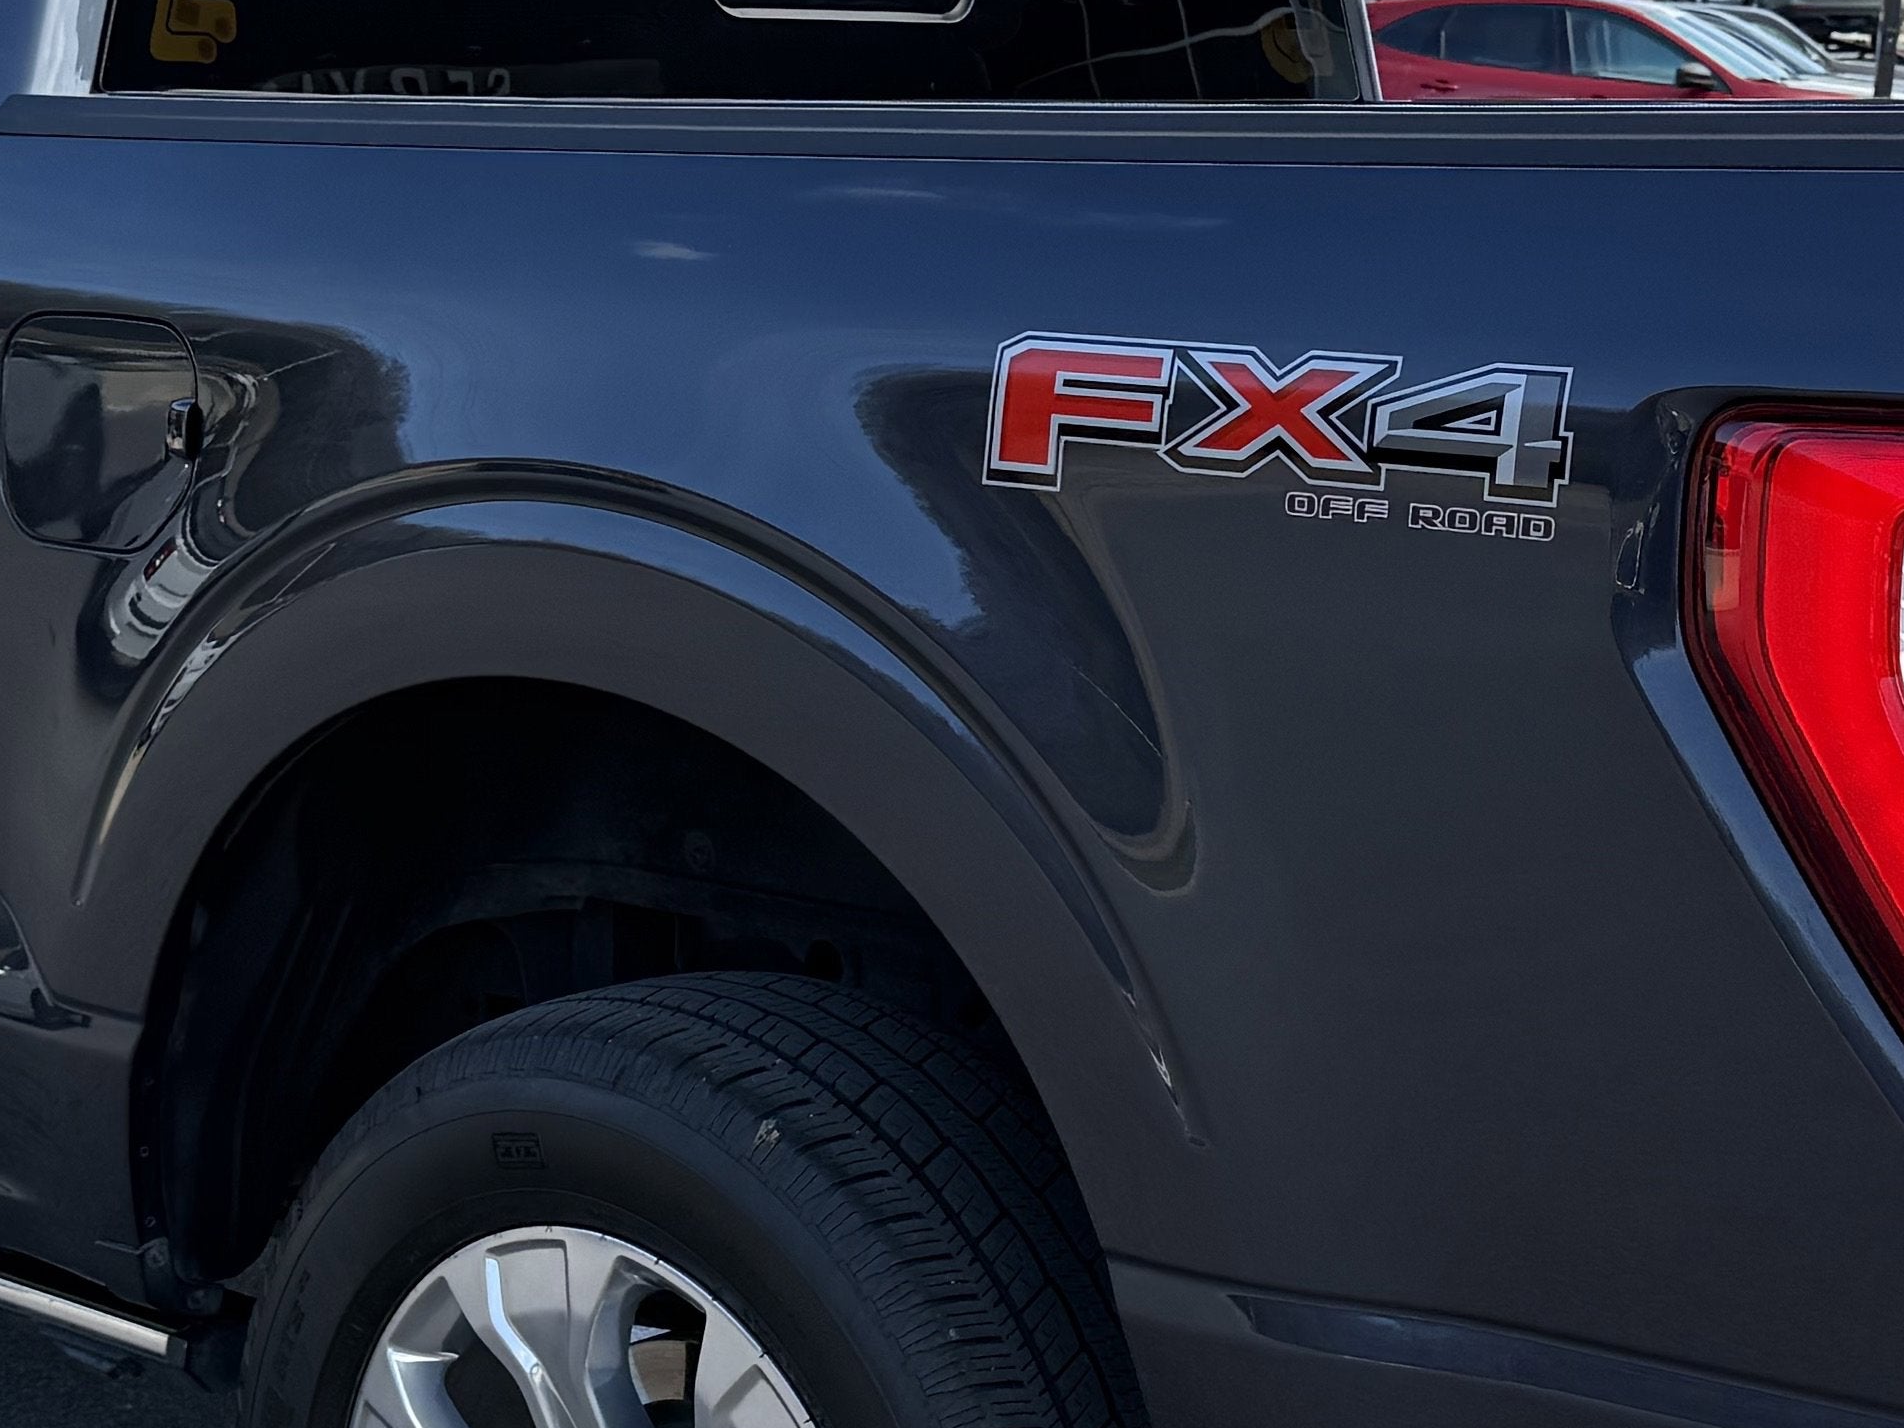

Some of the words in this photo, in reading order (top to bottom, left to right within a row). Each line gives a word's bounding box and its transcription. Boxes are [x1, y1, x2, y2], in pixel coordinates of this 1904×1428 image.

[982, 330, 1574, 508] FX4
[1284, 491, 1390, 524] OFF
[1407, 502, 1557, 543] ROAD
